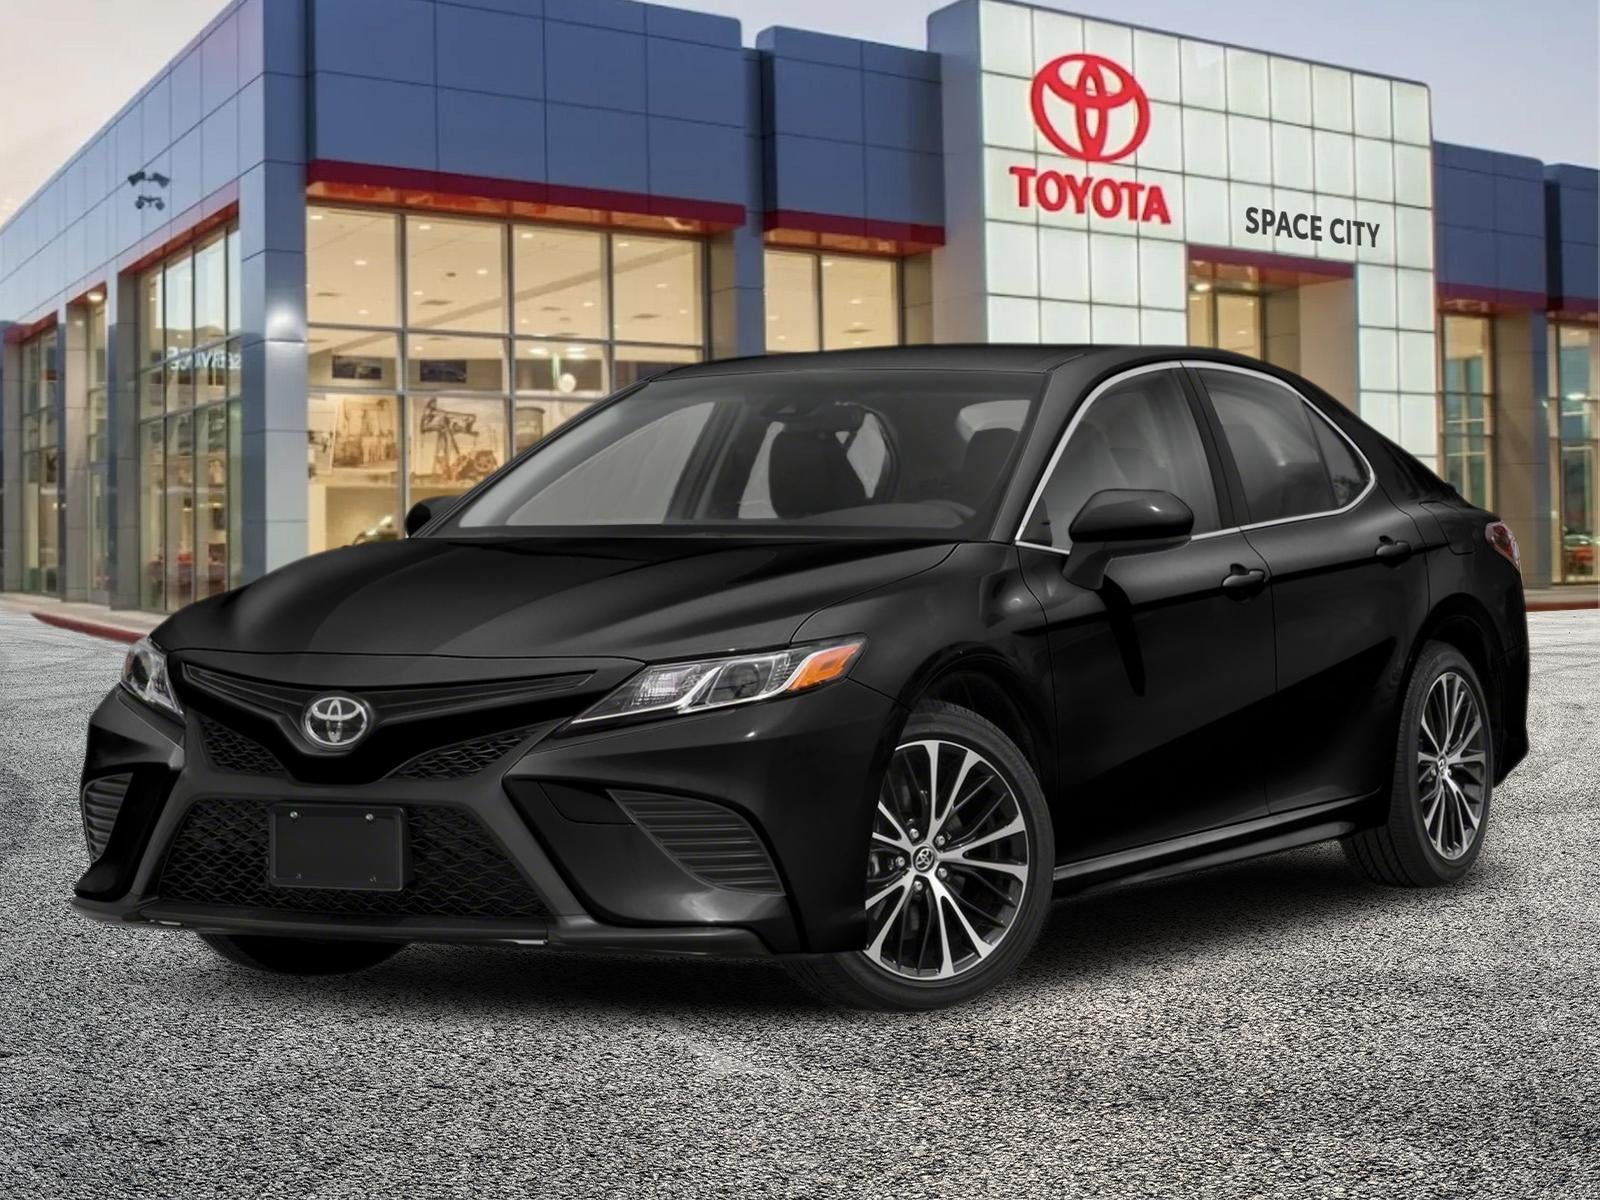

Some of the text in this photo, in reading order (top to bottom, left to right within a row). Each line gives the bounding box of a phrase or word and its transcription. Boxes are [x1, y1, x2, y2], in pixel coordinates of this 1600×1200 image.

[1009, 166, 1171, 224] TOYOTA
[1245, 206, 1380, 247] SPACE CITY
